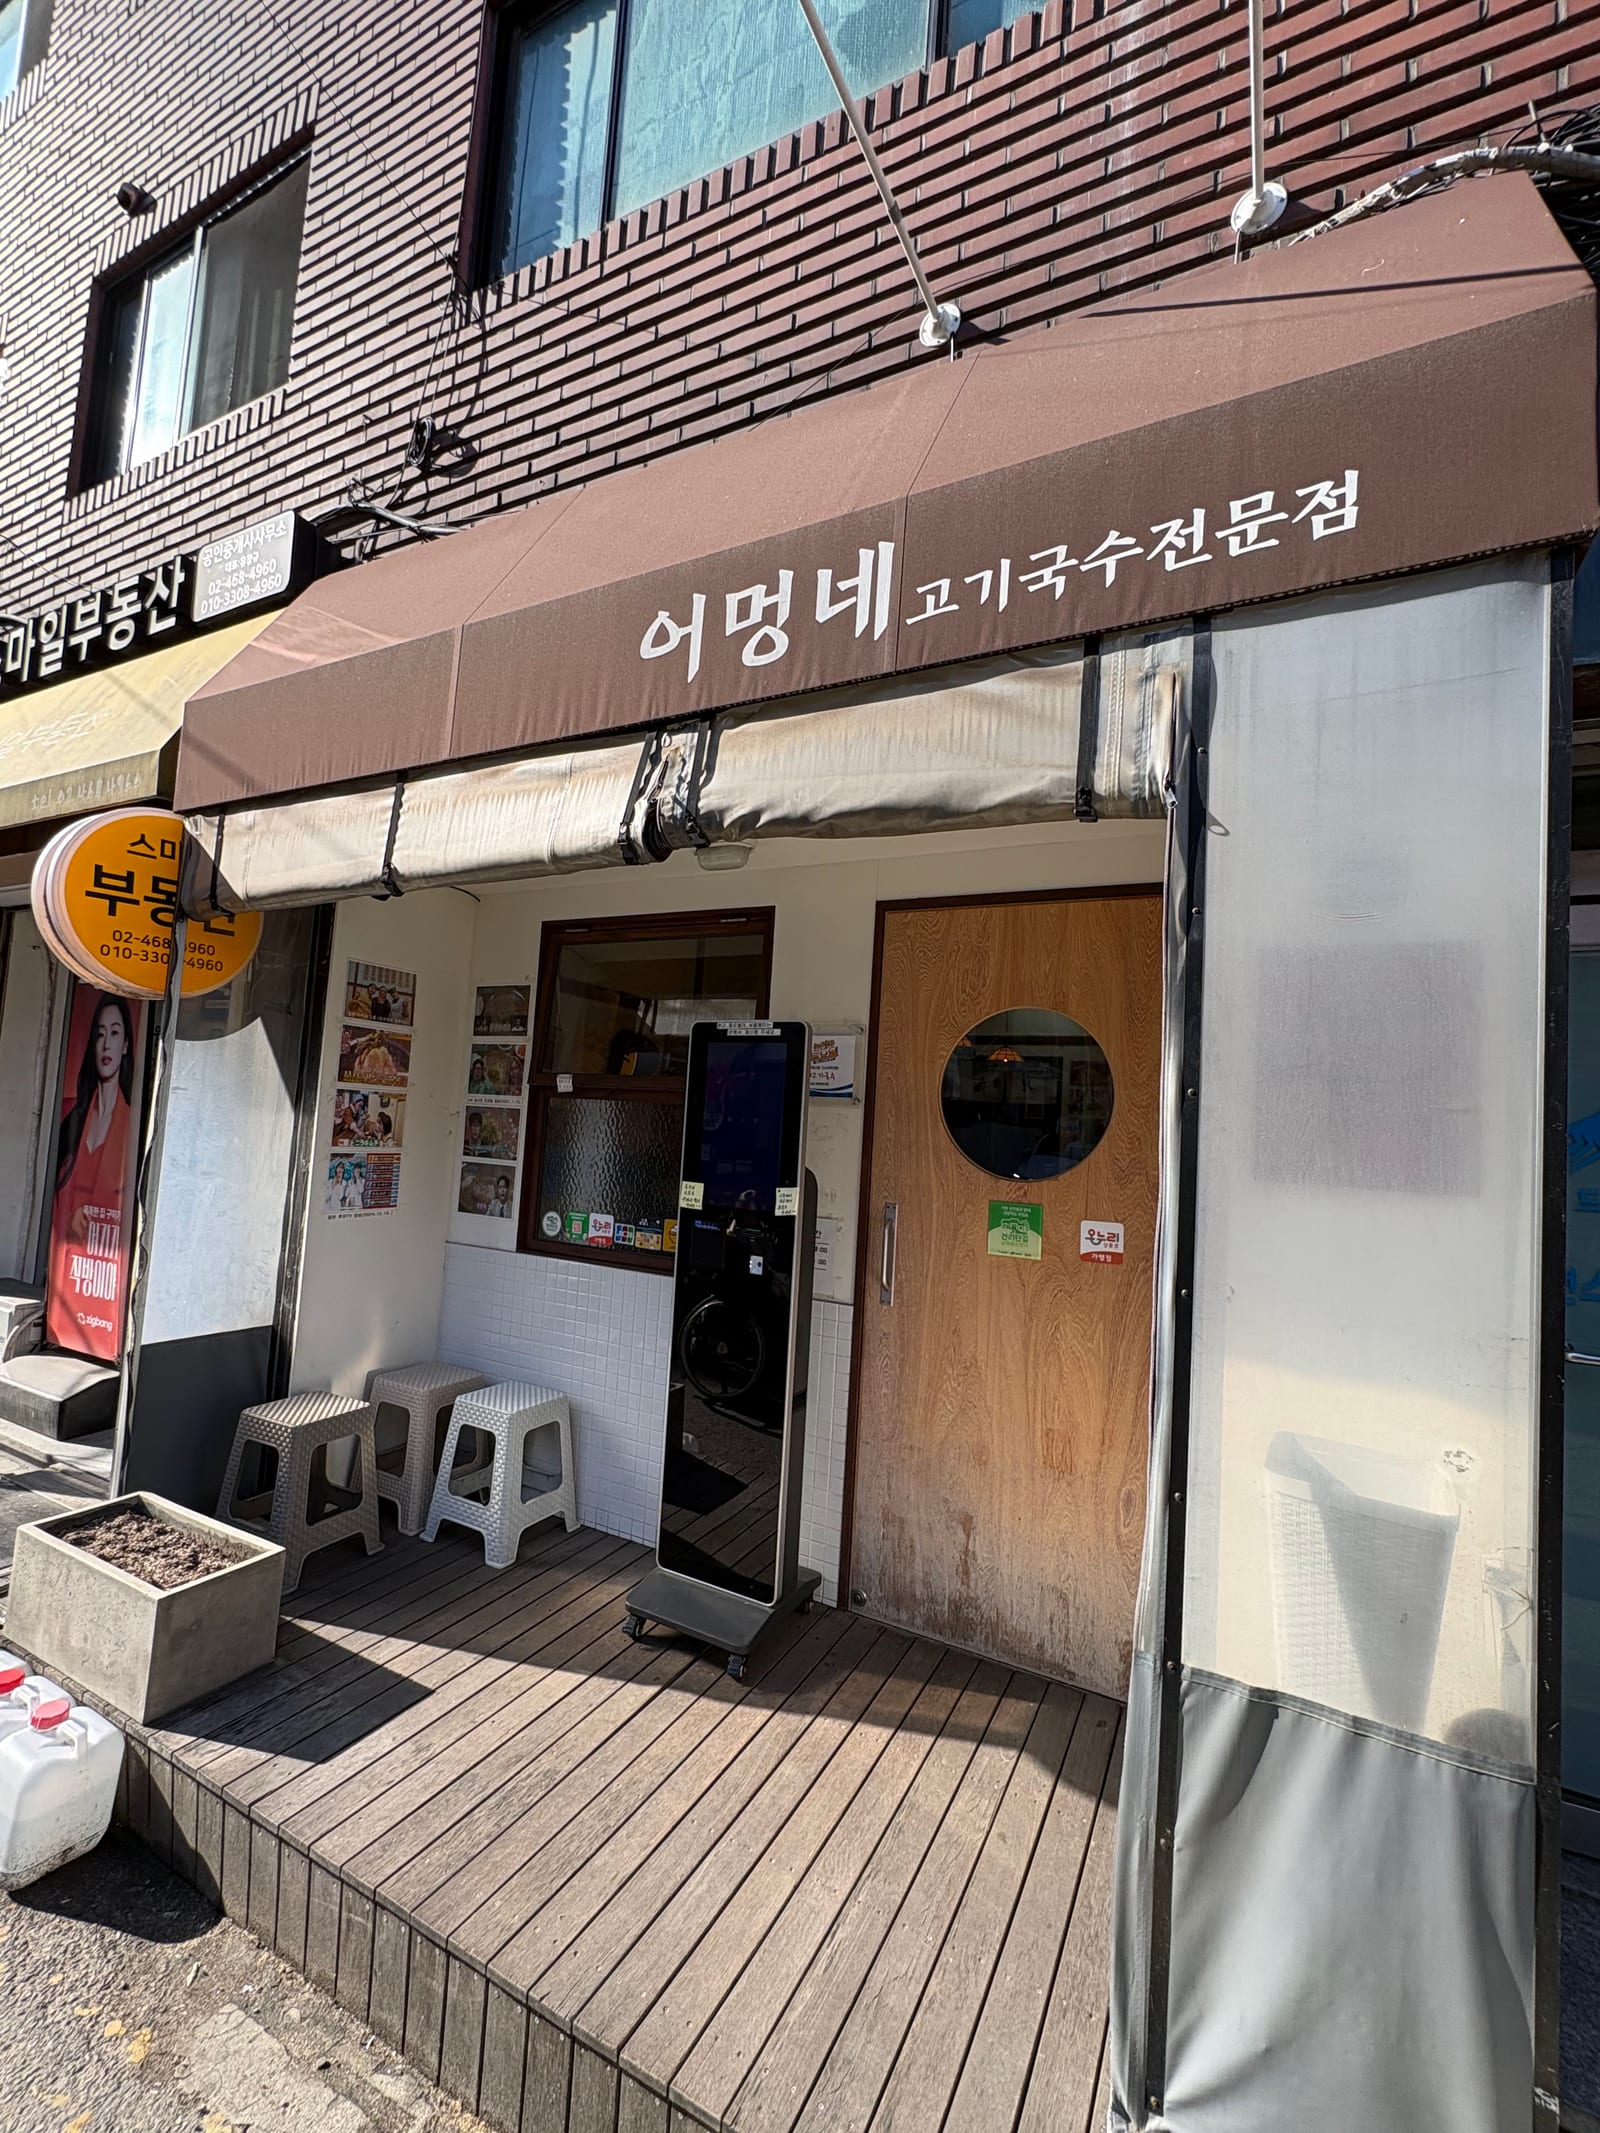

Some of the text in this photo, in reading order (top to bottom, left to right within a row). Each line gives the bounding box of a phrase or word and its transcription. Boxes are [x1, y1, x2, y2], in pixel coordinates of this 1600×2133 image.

[202, 519, 288, 567] 공인중개사사무소
[200, 573, 283, 614] 010-3308-4960
[208, 558, 277, 596] 02-468-4960
[638, 469, 1360, 684] 어멍네 고기국수전문점
[0, 555, 186, 683] 마일부동산
[1084, 1228, 1120, 1246] 온누리
[1090, 1253, 1112, 1262] 가맹점
[85, 1314, 113, 1333] zigbang
